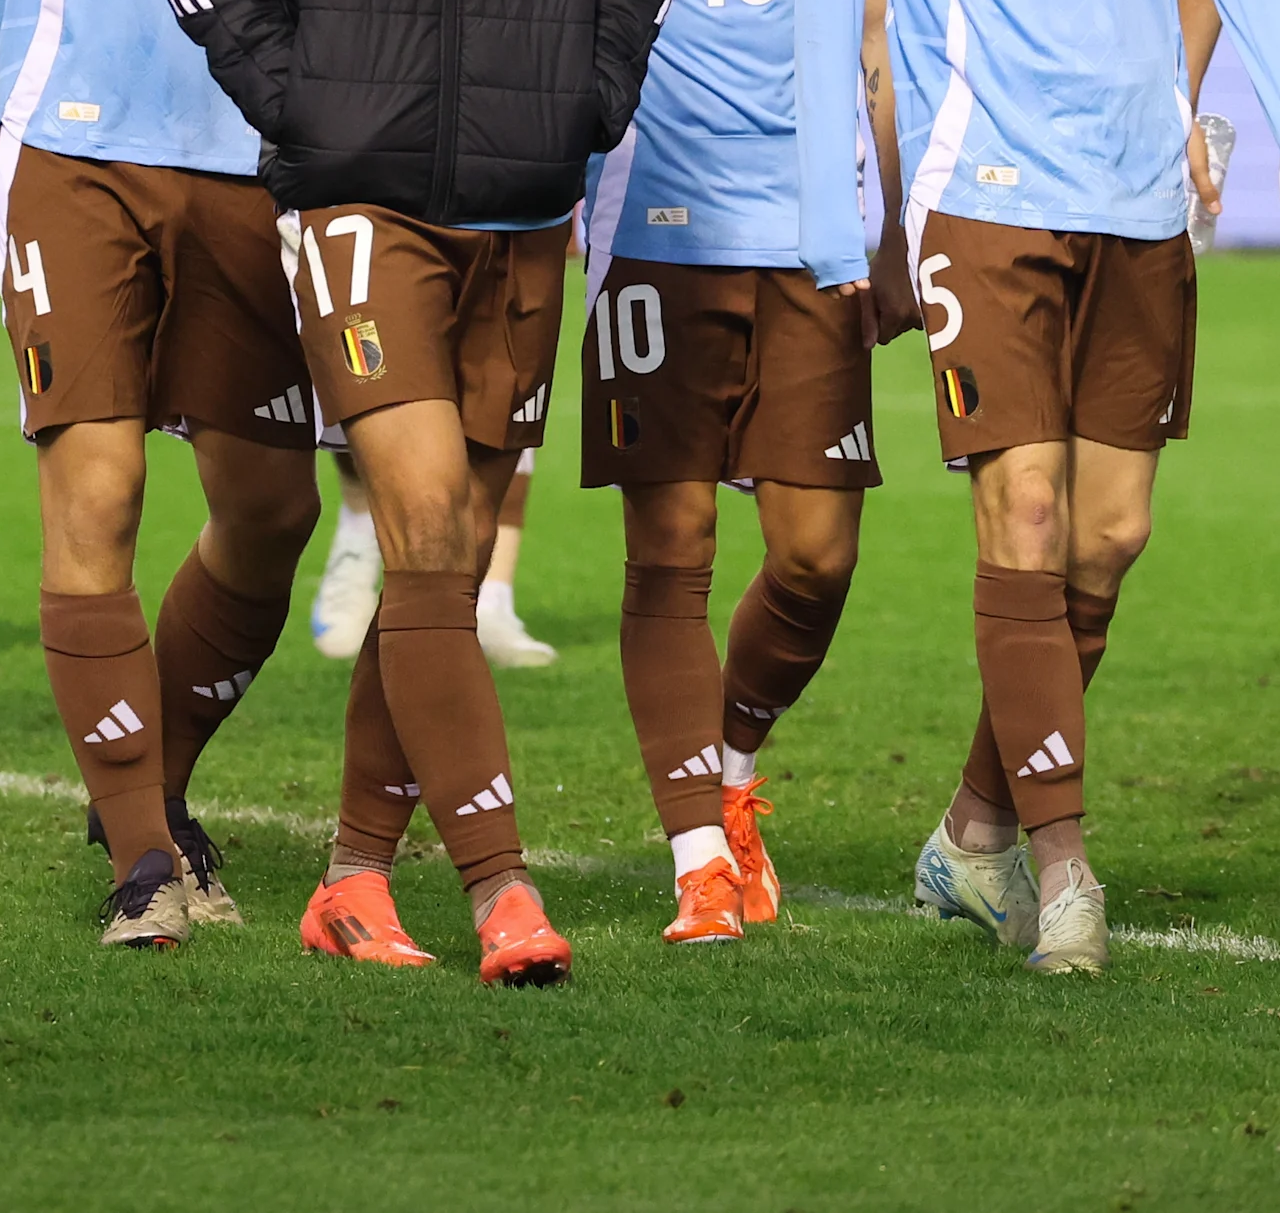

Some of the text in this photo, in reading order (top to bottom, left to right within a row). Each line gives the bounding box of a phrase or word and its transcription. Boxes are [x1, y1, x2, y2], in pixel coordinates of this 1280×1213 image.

[9, 233, 51, 316] 4
[303, 214, 373, 318] 17
[919, 253, 963, 352] 5
[596, 283, 665, 380] 10
